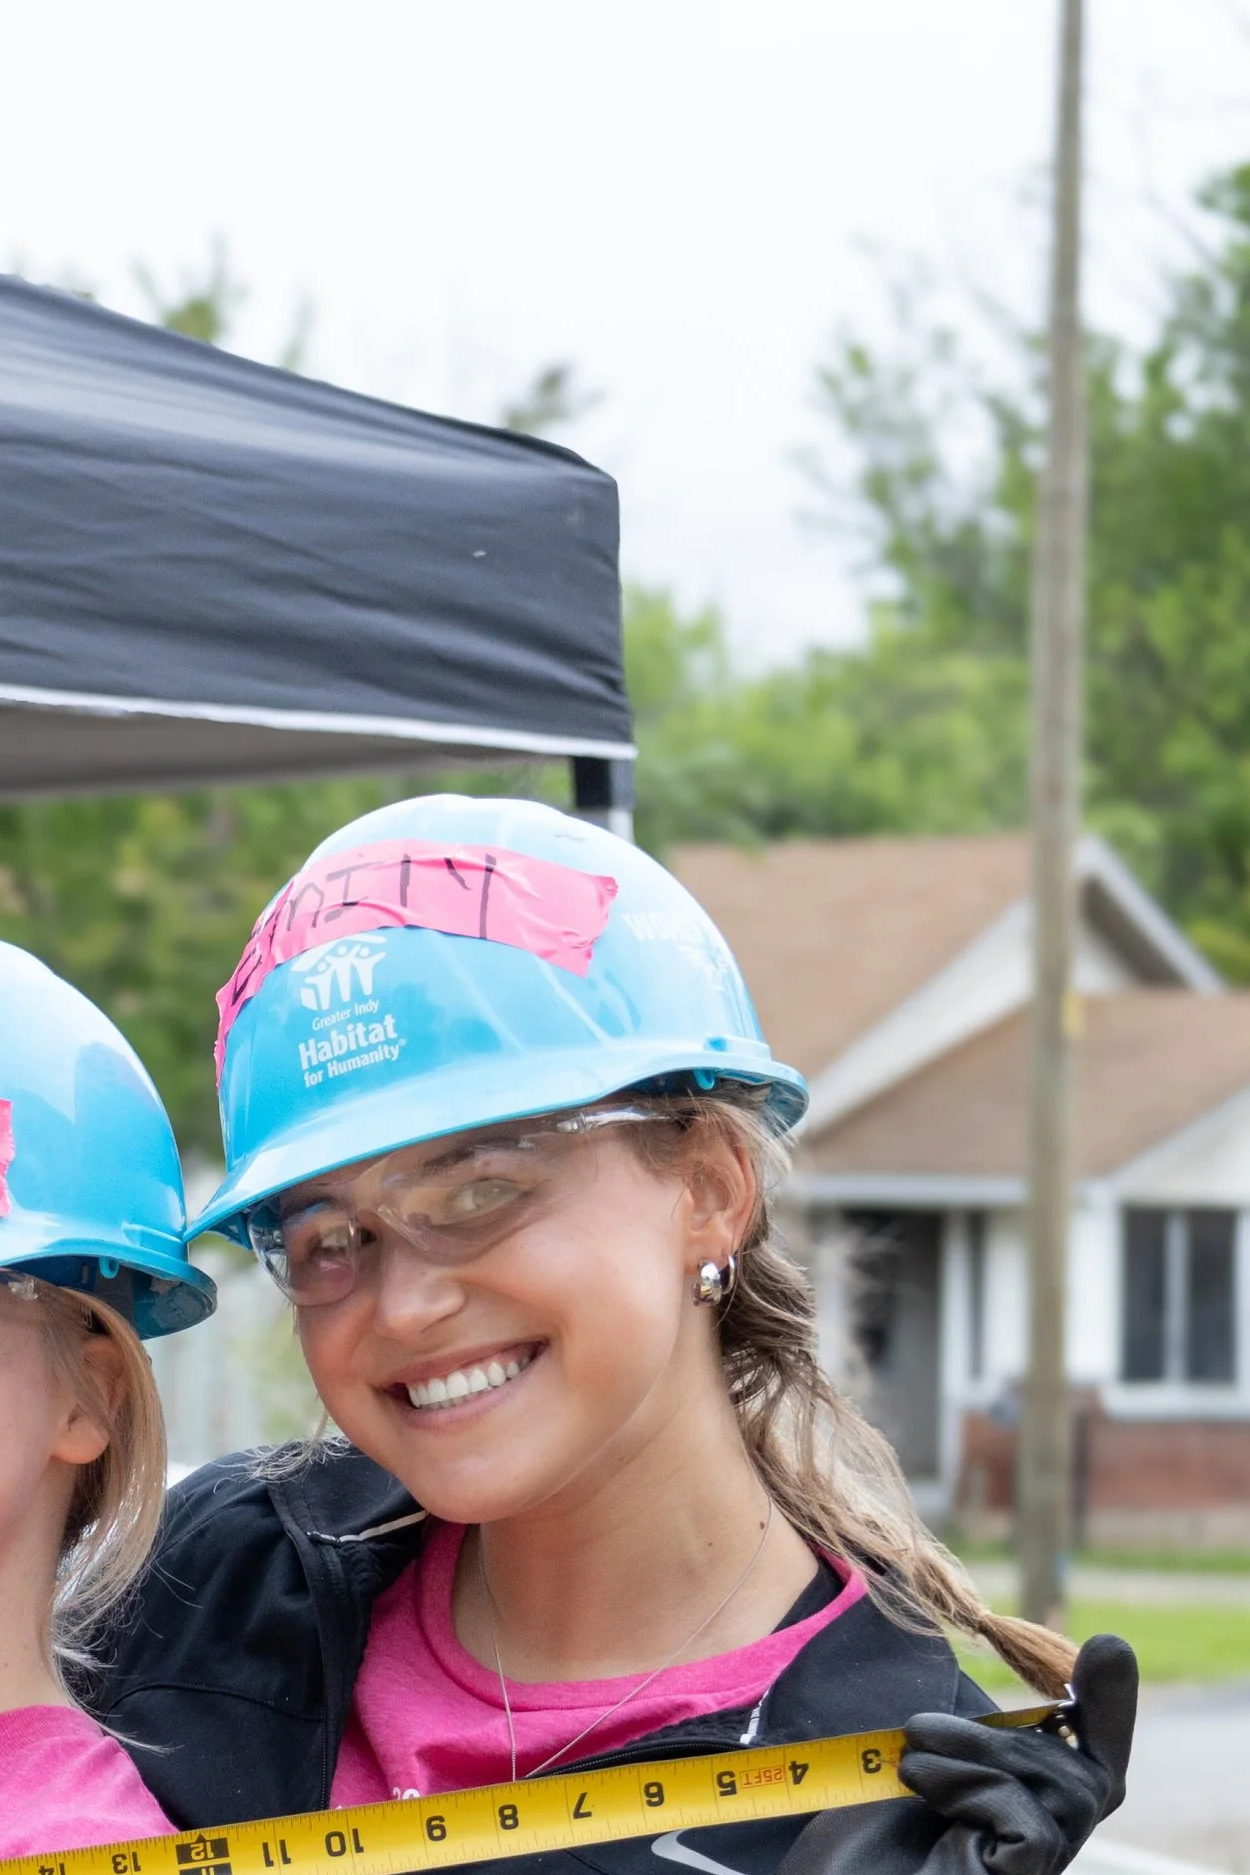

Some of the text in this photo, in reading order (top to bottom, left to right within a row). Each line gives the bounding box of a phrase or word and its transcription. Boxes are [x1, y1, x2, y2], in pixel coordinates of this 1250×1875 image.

[312, 998, 380, 1031] Greater Indy
[298, 1013, 398, 1071] Habitat
[304, 1069, 323, 1088] for
[788, 1760, 809, 1785] 4
[861, 1748, 882, 1774] 3
[716, 1770, 738, 1796] 5
[742, 1768, 783, 1787] 25FT
[572, 1791, 593, 1820] 7
[643, 1781, 665, 1807] 6
[425, 1815, 447, 1842] 9
[498, 1804, 519, 1830] 8
[190, 1842, 215, 1861] 12
[262, 1839, 291, 1868] 11
[324, 1828, 365, 1857] 10
[111, 1851, 142, 1875] 13
